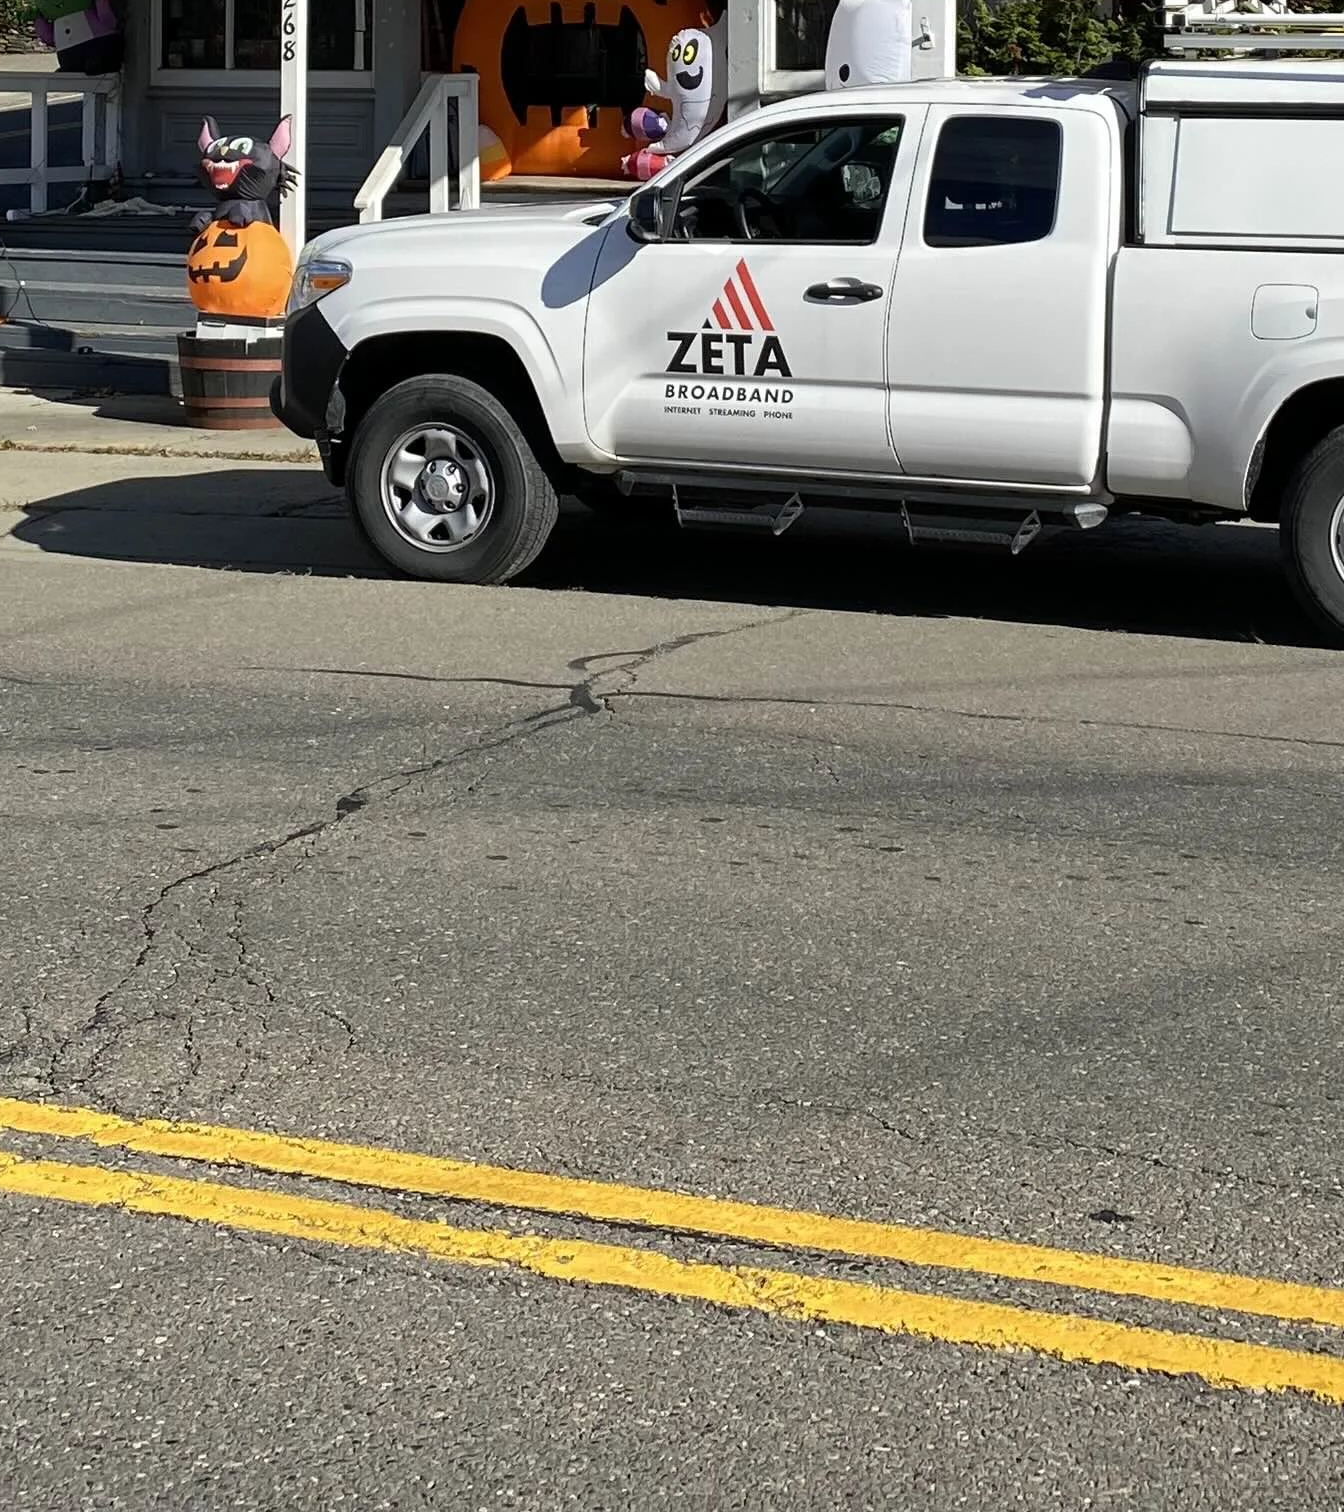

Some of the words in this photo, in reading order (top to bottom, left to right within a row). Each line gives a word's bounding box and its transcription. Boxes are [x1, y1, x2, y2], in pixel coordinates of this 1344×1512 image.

[666, 332, 793, 377] ZETA
[665, 384, 794, 404] BROADBAND
[664, 406, 702, 415] INTERNET
[708, 408, 756, 418] STREAMING
[763, 411, 793, 420] PHONE
